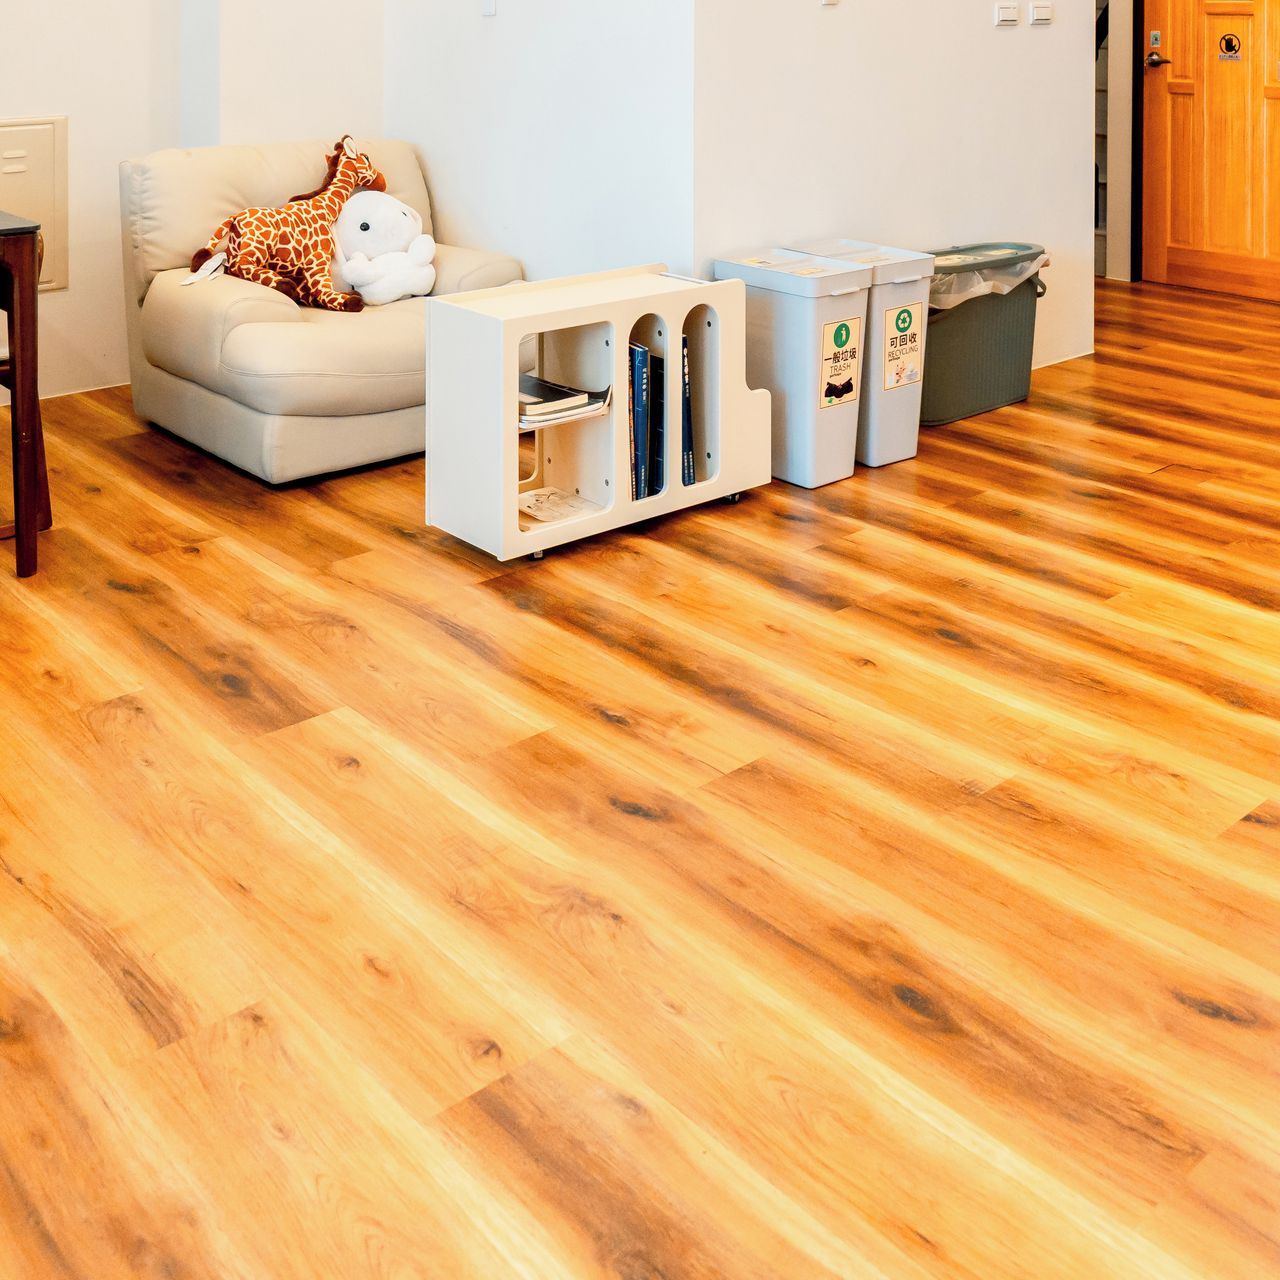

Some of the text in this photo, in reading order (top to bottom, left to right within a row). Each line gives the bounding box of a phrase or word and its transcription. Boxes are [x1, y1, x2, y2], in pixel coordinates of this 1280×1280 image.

[890, 332, 917, 348] 可回收
[824, 347, 857, 364] 一般垃圾
[888, 345, 918, 359] RECYCLING
[830, 363, 851, 375] TRASH
